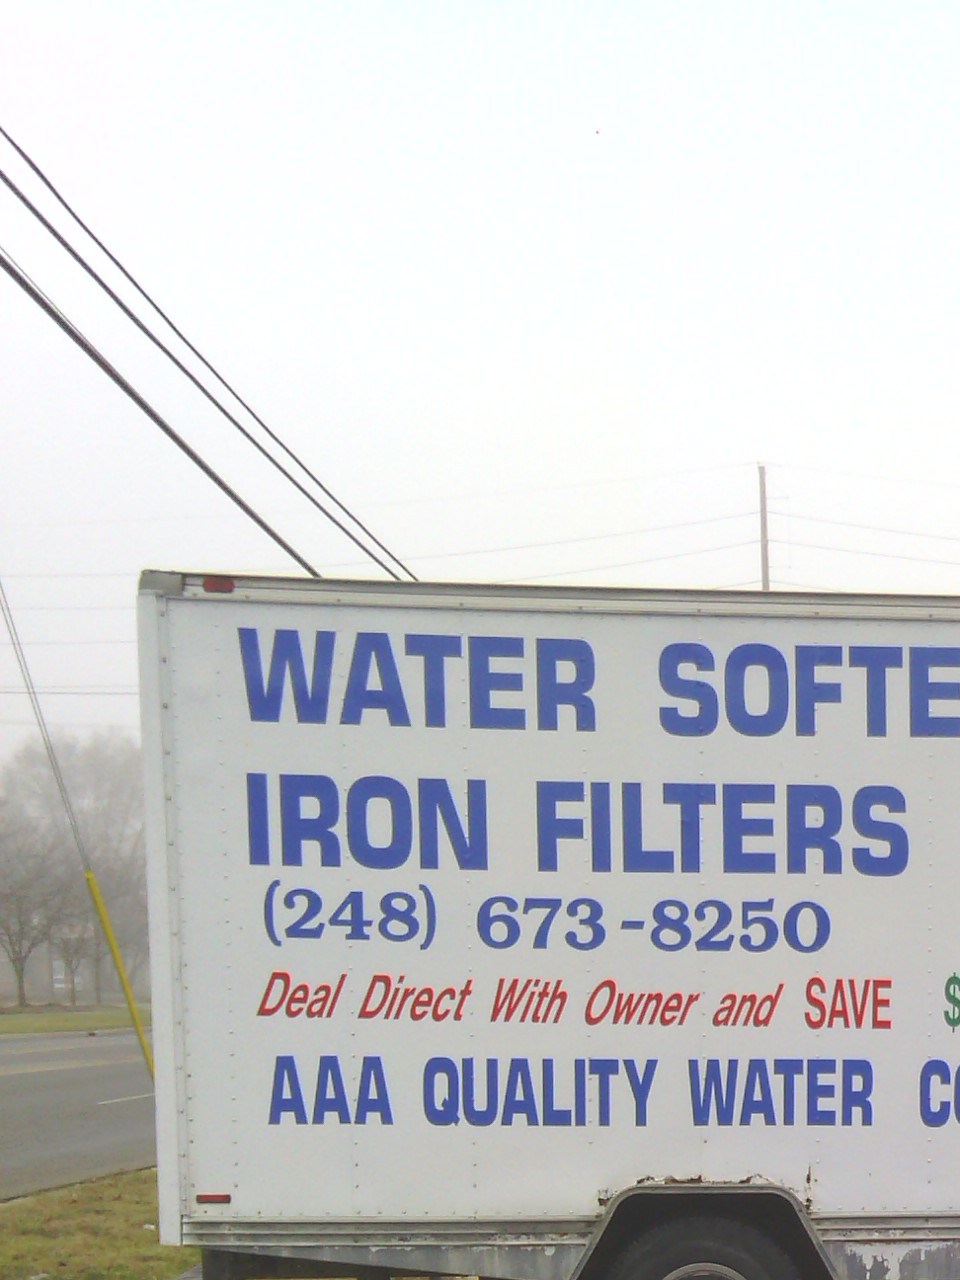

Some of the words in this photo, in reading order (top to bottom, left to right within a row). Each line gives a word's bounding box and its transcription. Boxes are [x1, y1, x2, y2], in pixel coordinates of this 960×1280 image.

[237, 626, 597, 732] WATER
[246, 772, 489, 870] IRON
[536, 780, 910, 876] FILTERS
[264, 879, 437, 950] (248)
[476, 895, 832, 953] 673-8250
[256, 970, 348, 1018] Deal
[357, 973, 474, 1021] Direct
[490, 977, 569, 1024] With
[584, 978, 700, 1026] Owner
[711, 982, 785, 1028] and
[804, 976, 894, 1030] SAVE
[268, 1054, 395, 1126] AAA
[422, 1055, 659, 1127] QUALITY
[688, 1057, 875, 1127] WATER
